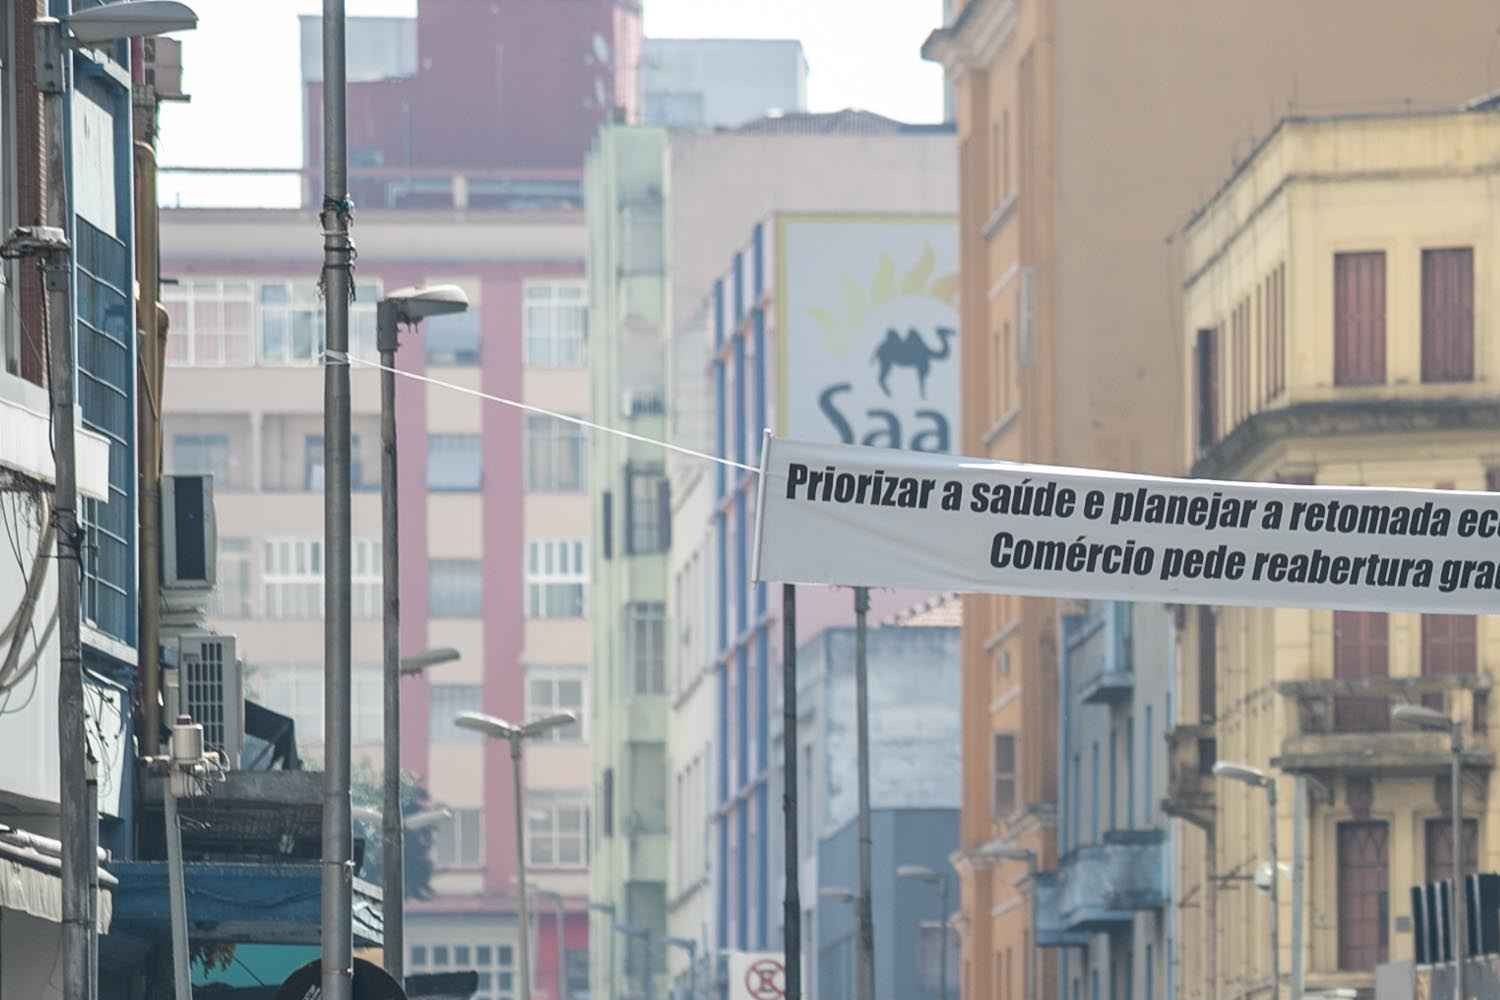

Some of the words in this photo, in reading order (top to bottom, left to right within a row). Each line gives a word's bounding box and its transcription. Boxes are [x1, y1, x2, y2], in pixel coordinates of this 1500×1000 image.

[786, 462, 936, 509] Priorizar
[941, 480, 963, 511] a
[970, 478, 1077, 518] saúde
[1083, 490, 1105, 520] e
[1110, 487, 1258, 531] planejar
[1261, 500, 1284, 530] a
[1288, 500, 1452, 537] retomada
[990, 531, 1155, 576] Comércio
[1159, 544, 1246, 581] pede
[1251, 549, 1434, 588] reabertura
